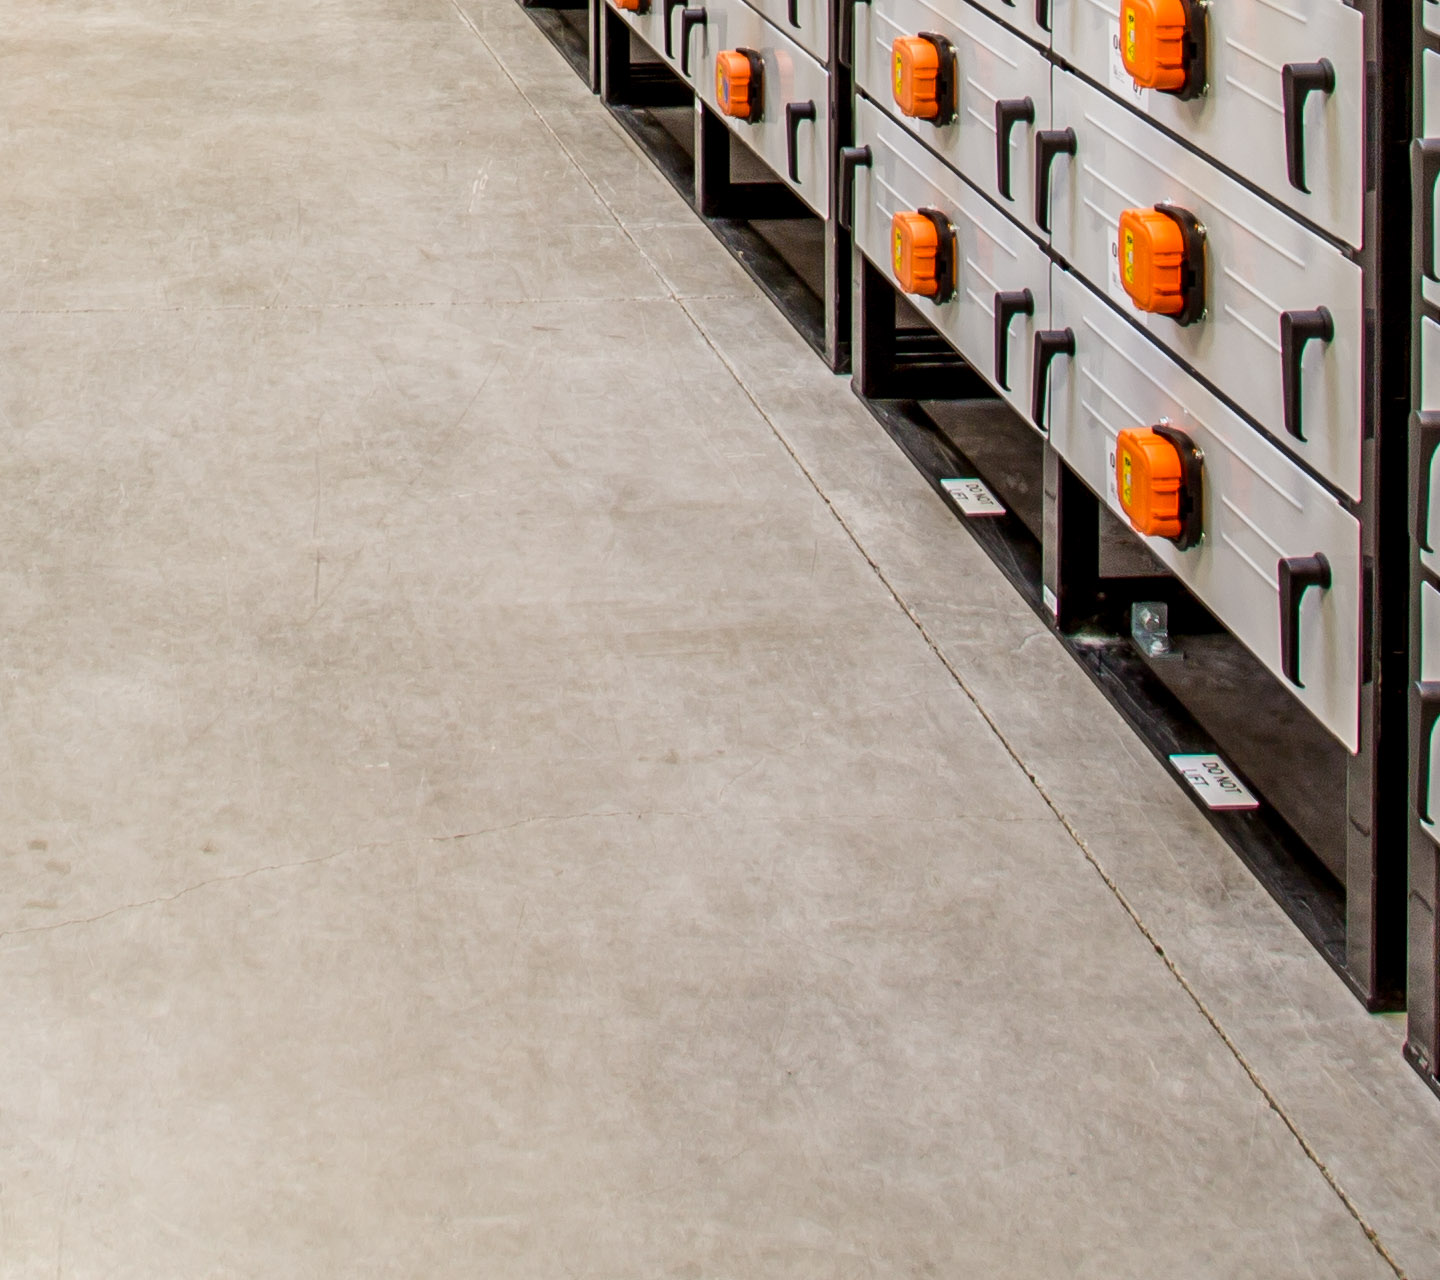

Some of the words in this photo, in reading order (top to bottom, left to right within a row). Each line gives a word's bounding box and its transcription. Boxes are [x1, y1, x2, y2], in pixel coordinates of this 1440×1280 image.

[948, 489, 968, 501] LIFT
[966, 484, 982, 492] DO
[976, 493, 994, 506] NOT
[1182, 769, 1210, 787] LIFT
[1202, 762, 1224, 775] DO
[1218, 776, 1242, 794] NOT
